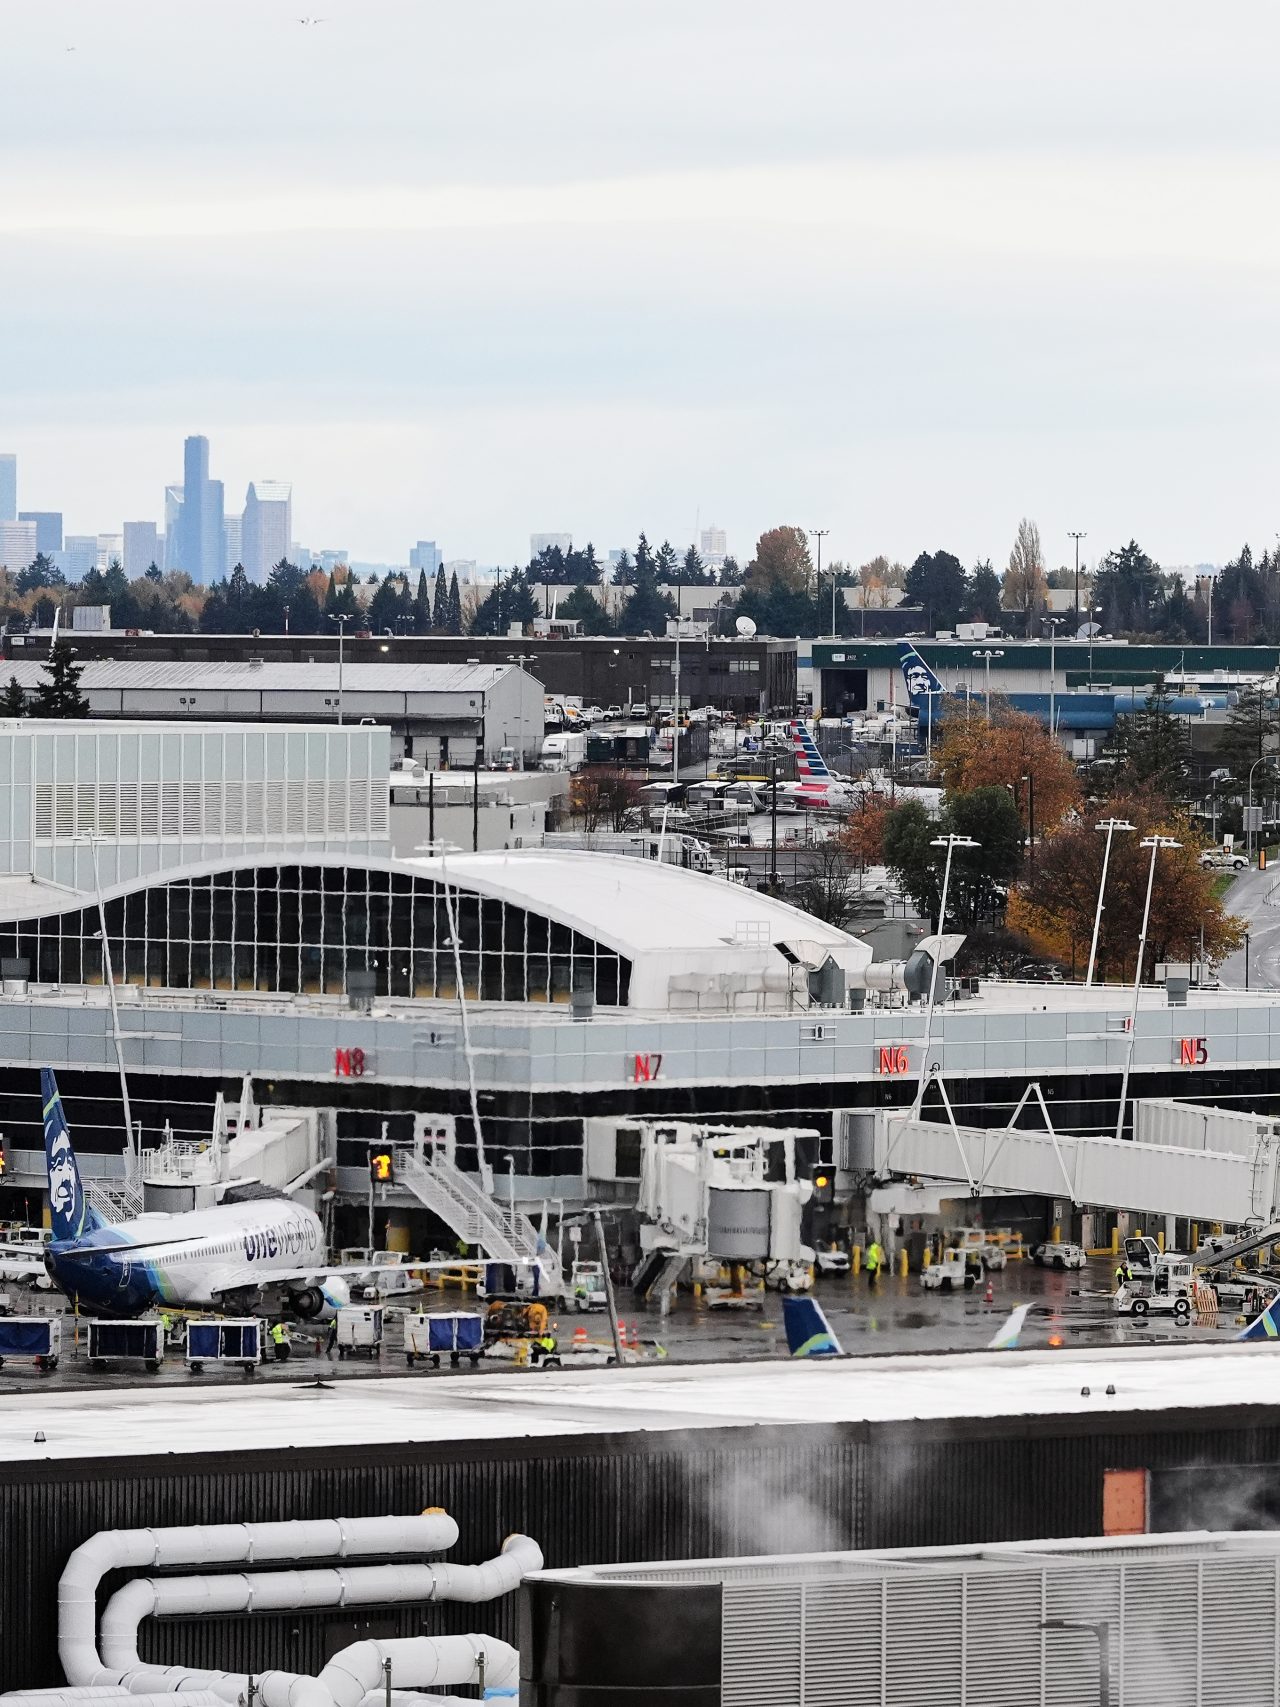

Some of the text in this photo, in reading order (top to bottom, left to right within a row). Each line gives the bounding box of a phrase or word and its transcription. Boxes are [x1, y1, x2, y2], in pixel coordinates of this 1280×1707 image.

[336, 1047, 365, 1077] N8
[879, 1046, 909, 1075] N6
[1181, 1038, 1208, 1065] N5
[634, 1054, 662, 1082] N7
